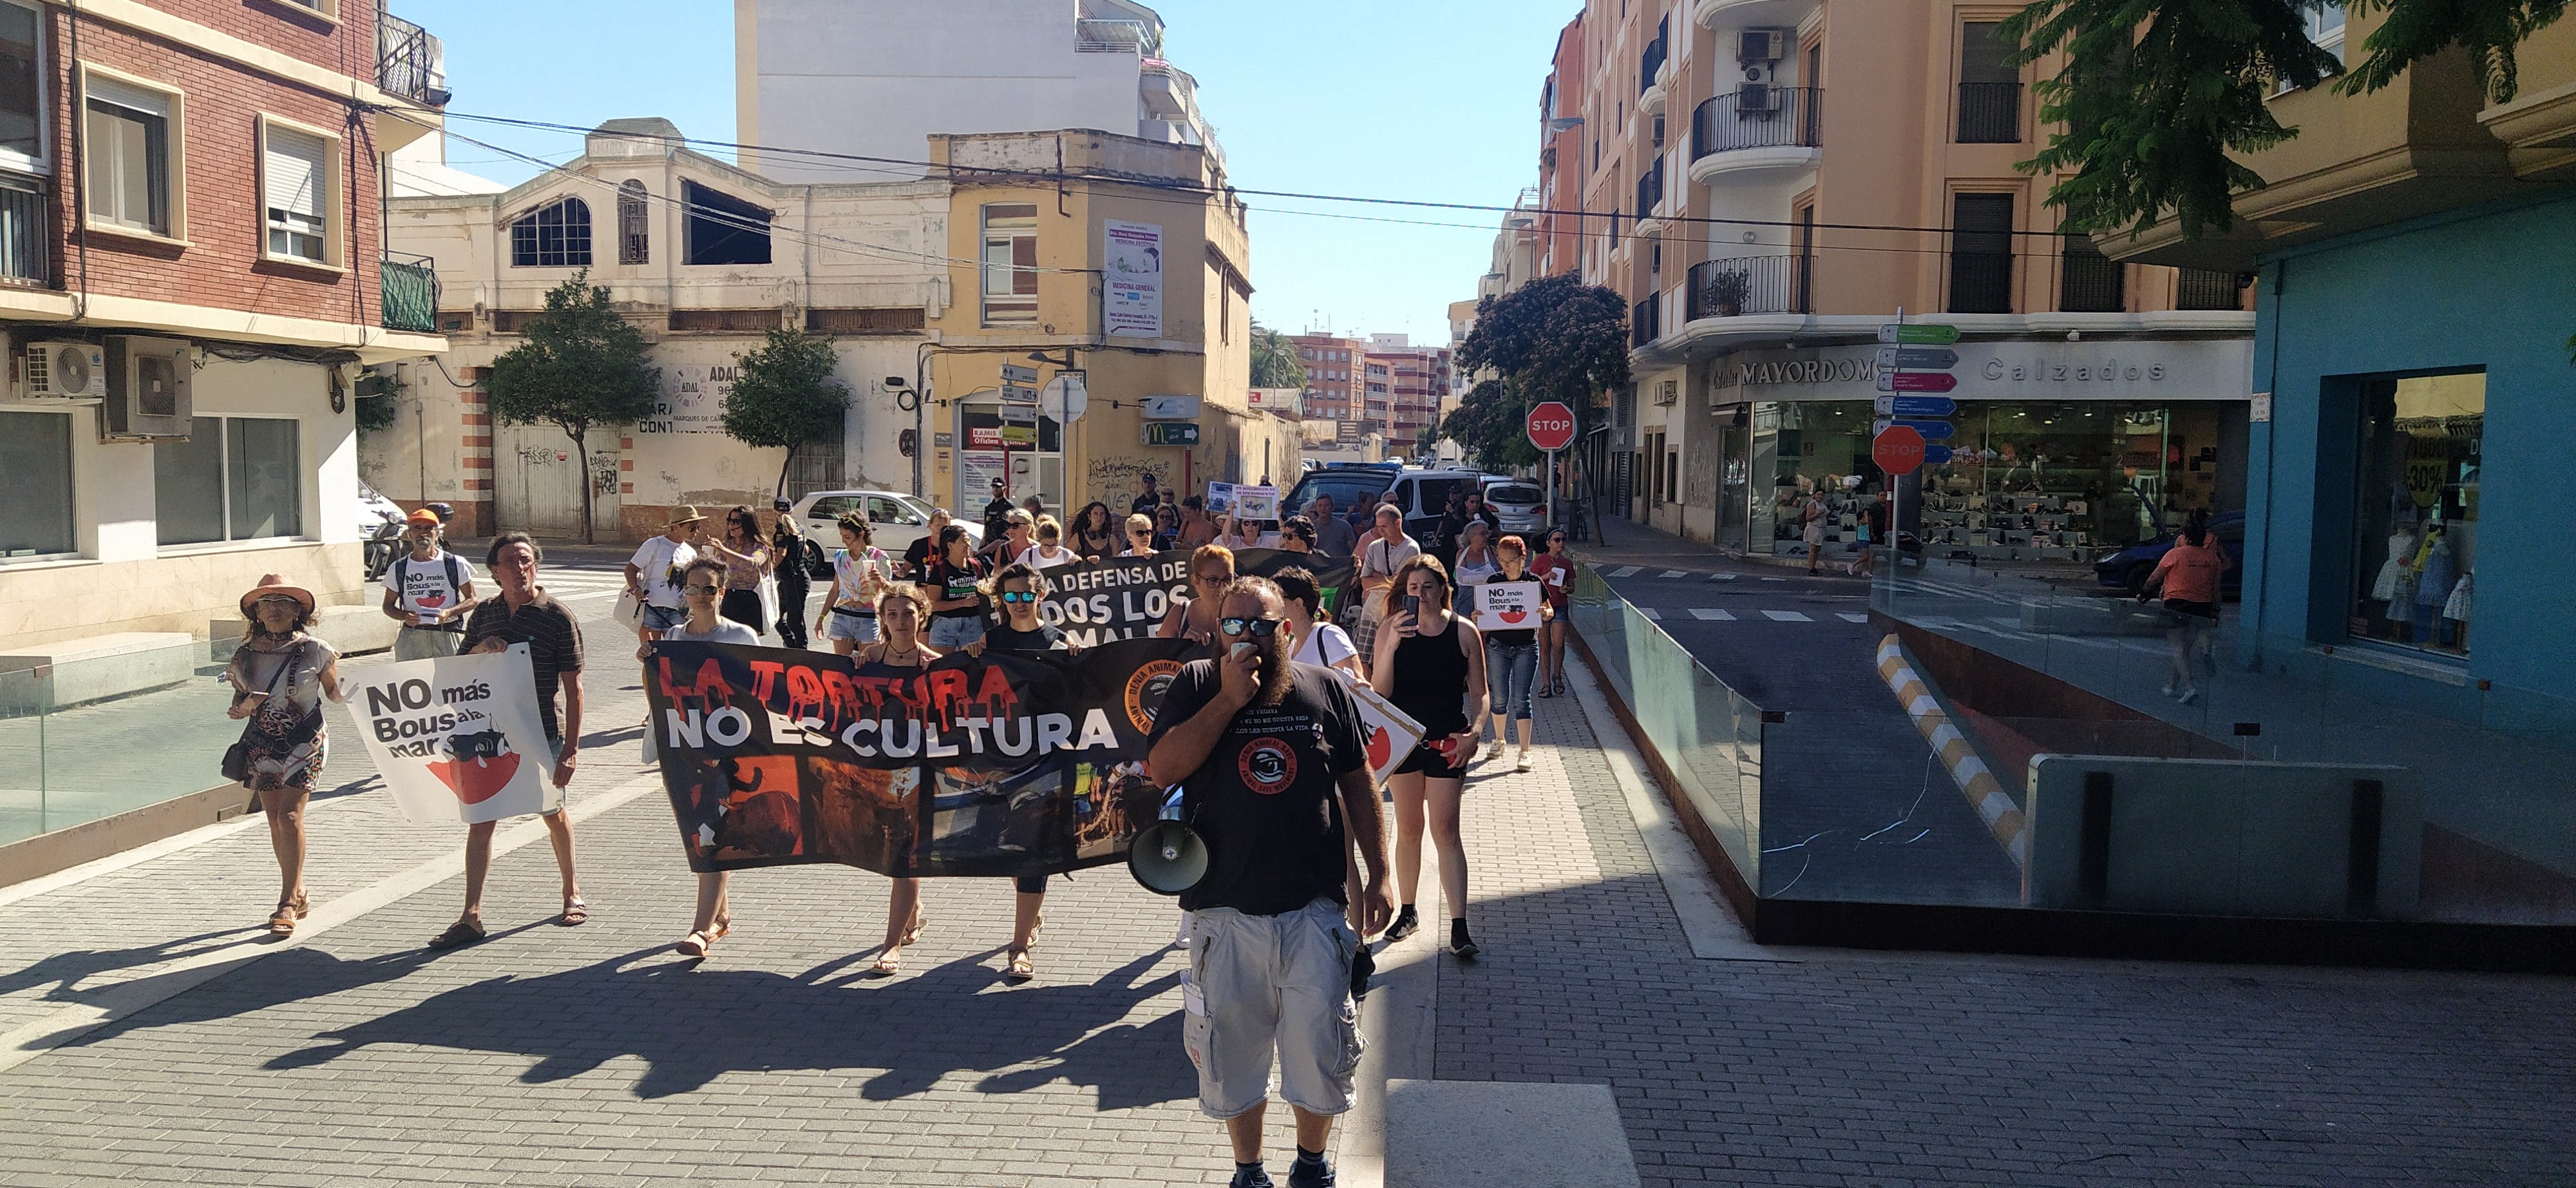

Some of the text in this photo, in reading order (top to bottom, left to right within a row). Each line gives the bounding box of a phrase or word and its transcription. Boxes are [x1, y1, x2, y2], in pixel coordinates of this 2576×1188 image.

[1741, 359, 1877, 385] MAYORDOM
[1982, 357, 2166, 381] Calzados
[681, 382, 699, 392] ADAL
[1533, 420, 1570, 431] STOP
[1879, 444, 1920, 455] STOP
[406, 573, 423, 583] NO
[1063, 566, 1158, 591] DEFENSA
[1162, 561, 1188, 581] DE
[1122, 584, 1190, 622] LOS
[1488, 588, 1504, 597] NO
[366, 678, 491, 717] NO más
[659, 656, 1019, 727] LA TORTURA
[372, 713, 456, 743] Bous
[666, 706, 1119, 758] NO ES CULTURA
[385, 736, 440, 758] mar
